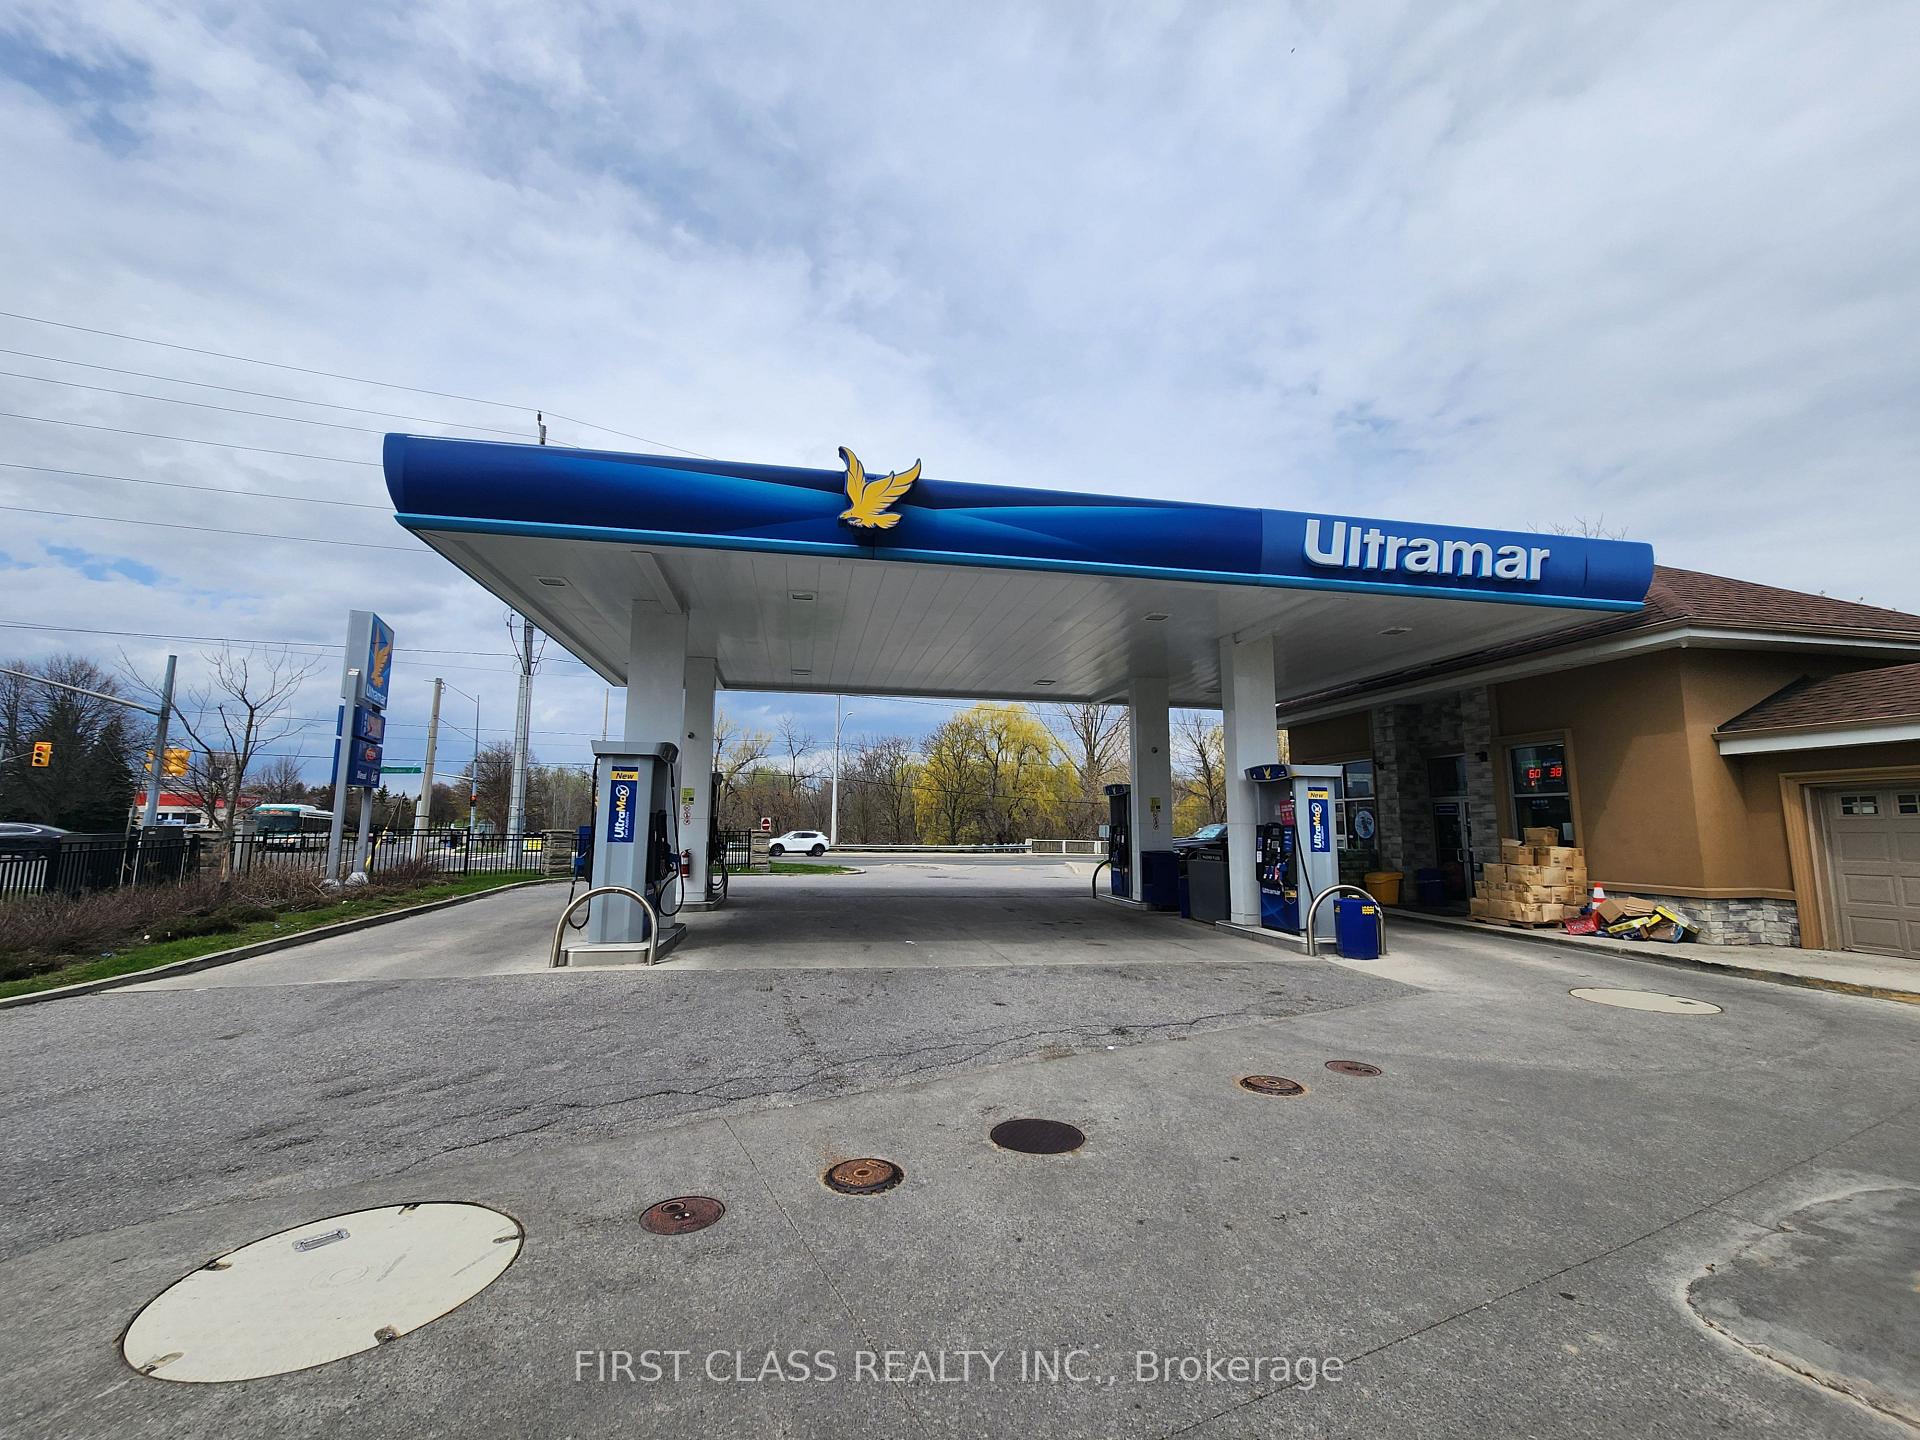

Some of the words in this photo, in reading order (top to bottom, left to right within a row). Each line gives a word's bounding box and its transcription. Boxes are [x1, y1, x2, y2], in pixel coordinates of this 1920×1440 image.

[1303, 518, 1550, 582] Ultramar
[366, 684, 387, 705] Ultramar
[615, 772, 635, 780] New
[1529, 769, 1541, 778] 60
[1550, 767, 1562, 777] 38
[614, 784, 630, 838] UltraMax
[1311, 802, 1323, 849] UltraMax
